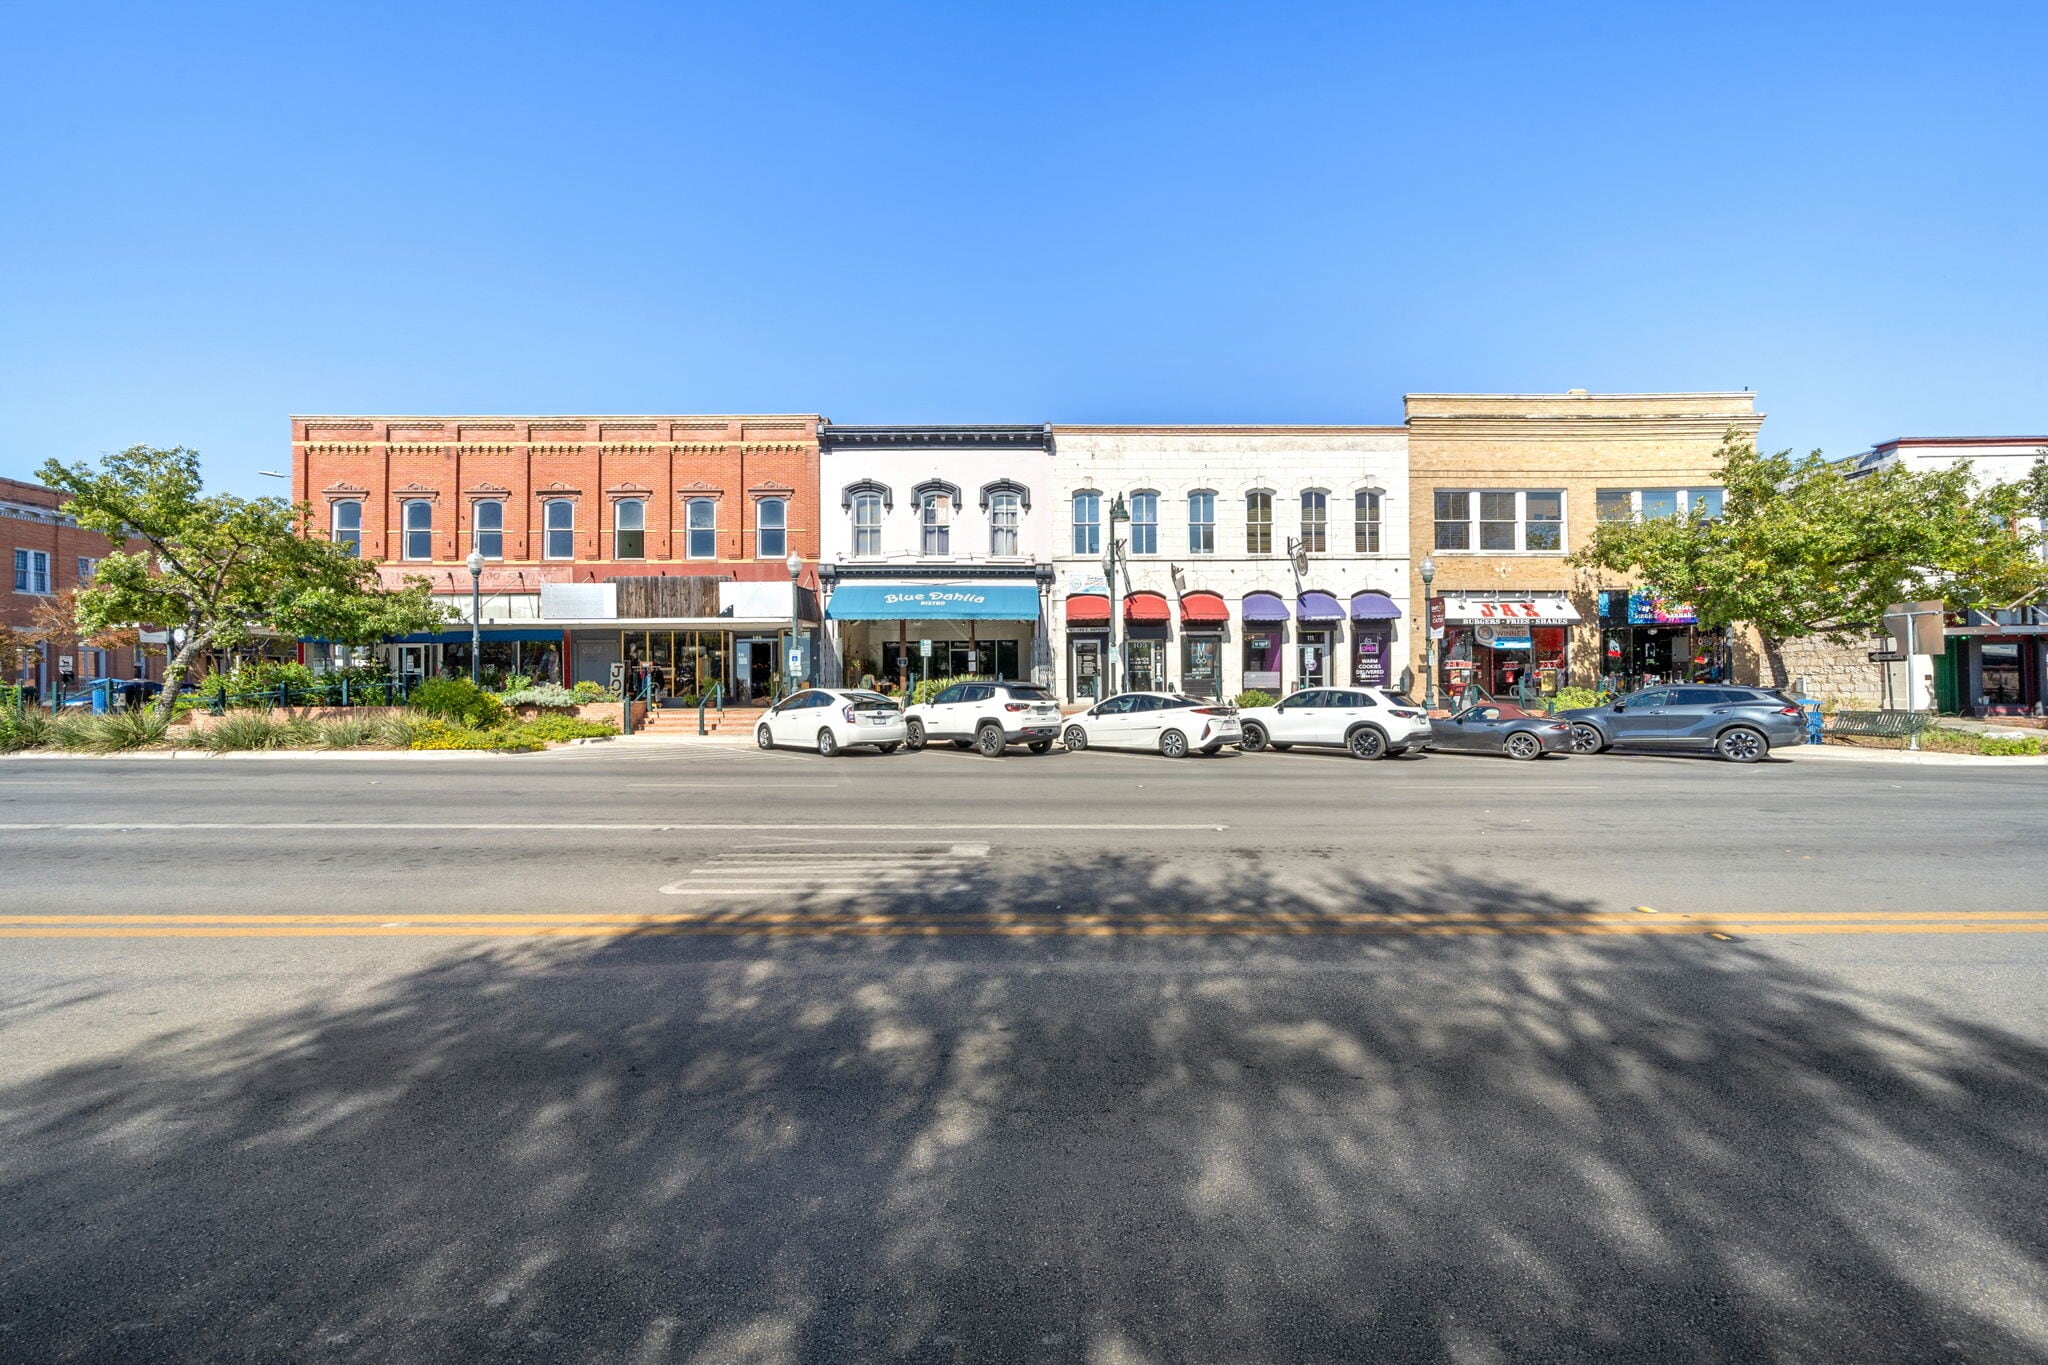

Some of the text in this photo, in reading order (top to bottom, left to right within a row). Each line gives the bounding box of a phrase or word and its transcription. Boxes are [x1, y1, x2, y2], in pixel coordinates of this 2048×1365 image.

[884, 592, 985, 604] Blue Dahlia
[1480, 604, 1541, 617] JAX
